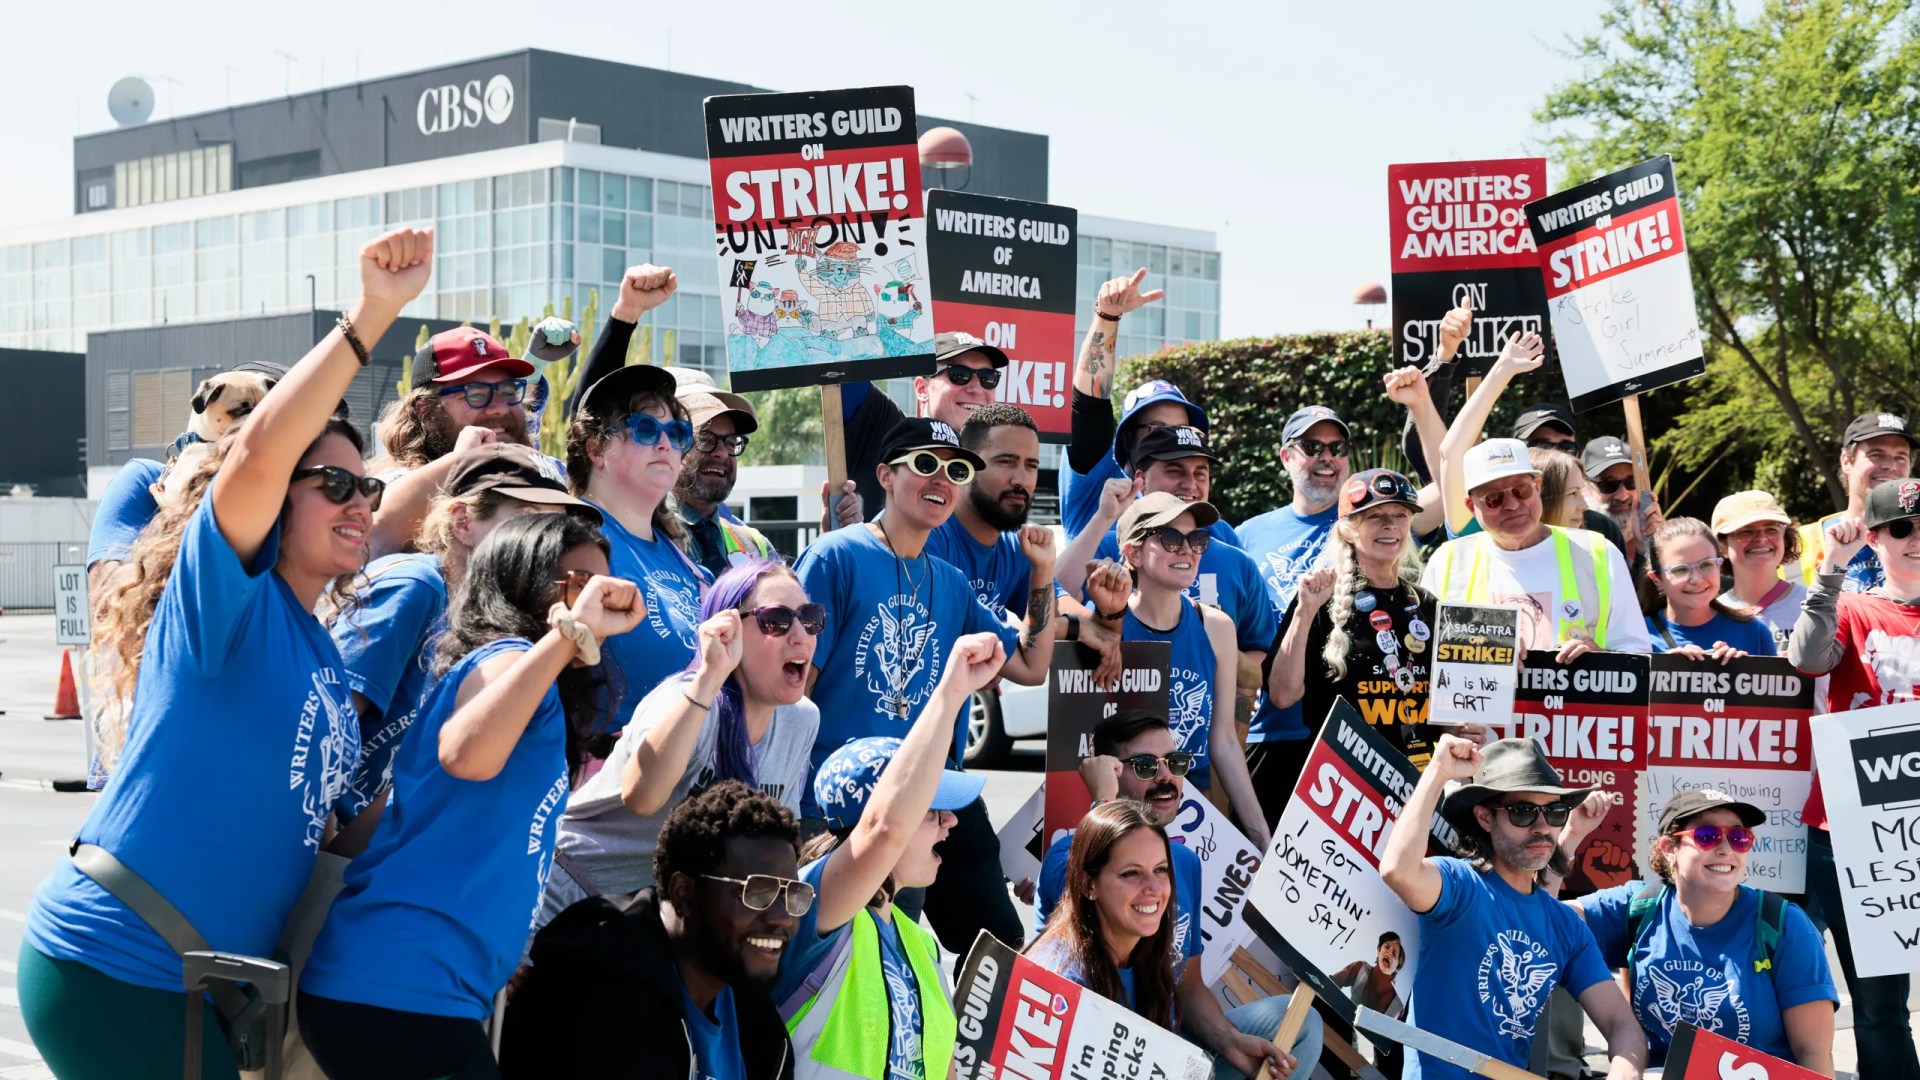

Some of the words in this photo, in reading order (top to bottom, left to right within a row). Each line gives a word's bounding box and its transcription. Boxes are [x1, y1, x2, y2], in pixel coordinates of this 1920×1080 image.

[417, 80, 483, 136] CBS
[719, 112, 828, 143] WRITERS
[832, 107, 902, 136] GUILD
[801, 143, 824, 161] ON
[726, 157, 909, 222] STRIKE!
[1399, 174, 1532, 204] WRITERS
[1538, 190, 1613, 233] WRITERS
[1613, 173, 1665, 207] GUILD
[936, 208, 1015, 239] WRITERS
[1019, 219, 1070, 246] GUILD
[1406, 203, 1499, 232] GUILD
[1595, 214, 1612, 230] ON
[993, 246, 1013, 266] OF
[1401, 228, 1538, 259] AMERICA
[1550, 209, 1673, 289] STRIKE!
[960, 270, 1041, 299] AMERICA
[1452, 282, 1488, 311] ON
[984, 321, 1016, 350] ON
[1601, 303, 1641, 339] Girl
[994, 360, 1066, 409] IKE!
[60, 573, 79, 591] LOT
[66, 595, 77, 614] IS
[888, 594, 915, 609] GUILD
[916, 602, 929, 619] OF
[60, 617, 86, 637] FULL
[855, 615, 880, 679] WRITERS
[1437, 644, 1513, 664] STRIKE!
[923, 638, 940, 698] AMERICA
[1122, 668, 1162, 693] GUILD
[1182, 669, 1200, 682] OF
[1516, 668, 1570, 691] TERS
[1573, 670, 1638, 694] GUILD
[1464, 677, 1474, 690] is
[1734, 673, 1802, 697] GUILD
[1453, 692, 1491, 712] ART
[1544, 695, 1564, 710] ON
[1703, 698, 1725, 713] ON
[290, 690, 321, 791] WRITERS
[1337, 719, 1416, 803] WRITERS
[834, 773, 864, 804] WGA
[1568, 769, 1616, 785] LONG
[1718, 778, 1782, 806] showing
[527, 771, 569, 855] WRITERS
[1297, 819, 1309, 838] I
[1321, 839, 1363, 876] GOT
[1202, 849, 1262, 928] LINES
[1279, 870, 1301, 904] TO
[1308, 903, 1356, 950] SAY!
[1506, 930, 1531, 945] UILD
[1531, 942, 1549, 959] OF
[1478, 943, 1499, 1004] WRITERS
[1663, 959, 1704, 972] GUILD
[1705, 967, 1724, 982] OF
[959, 955, 999, 1041] GUILD
[1729, 994, 1751, 1045] AMERIC
